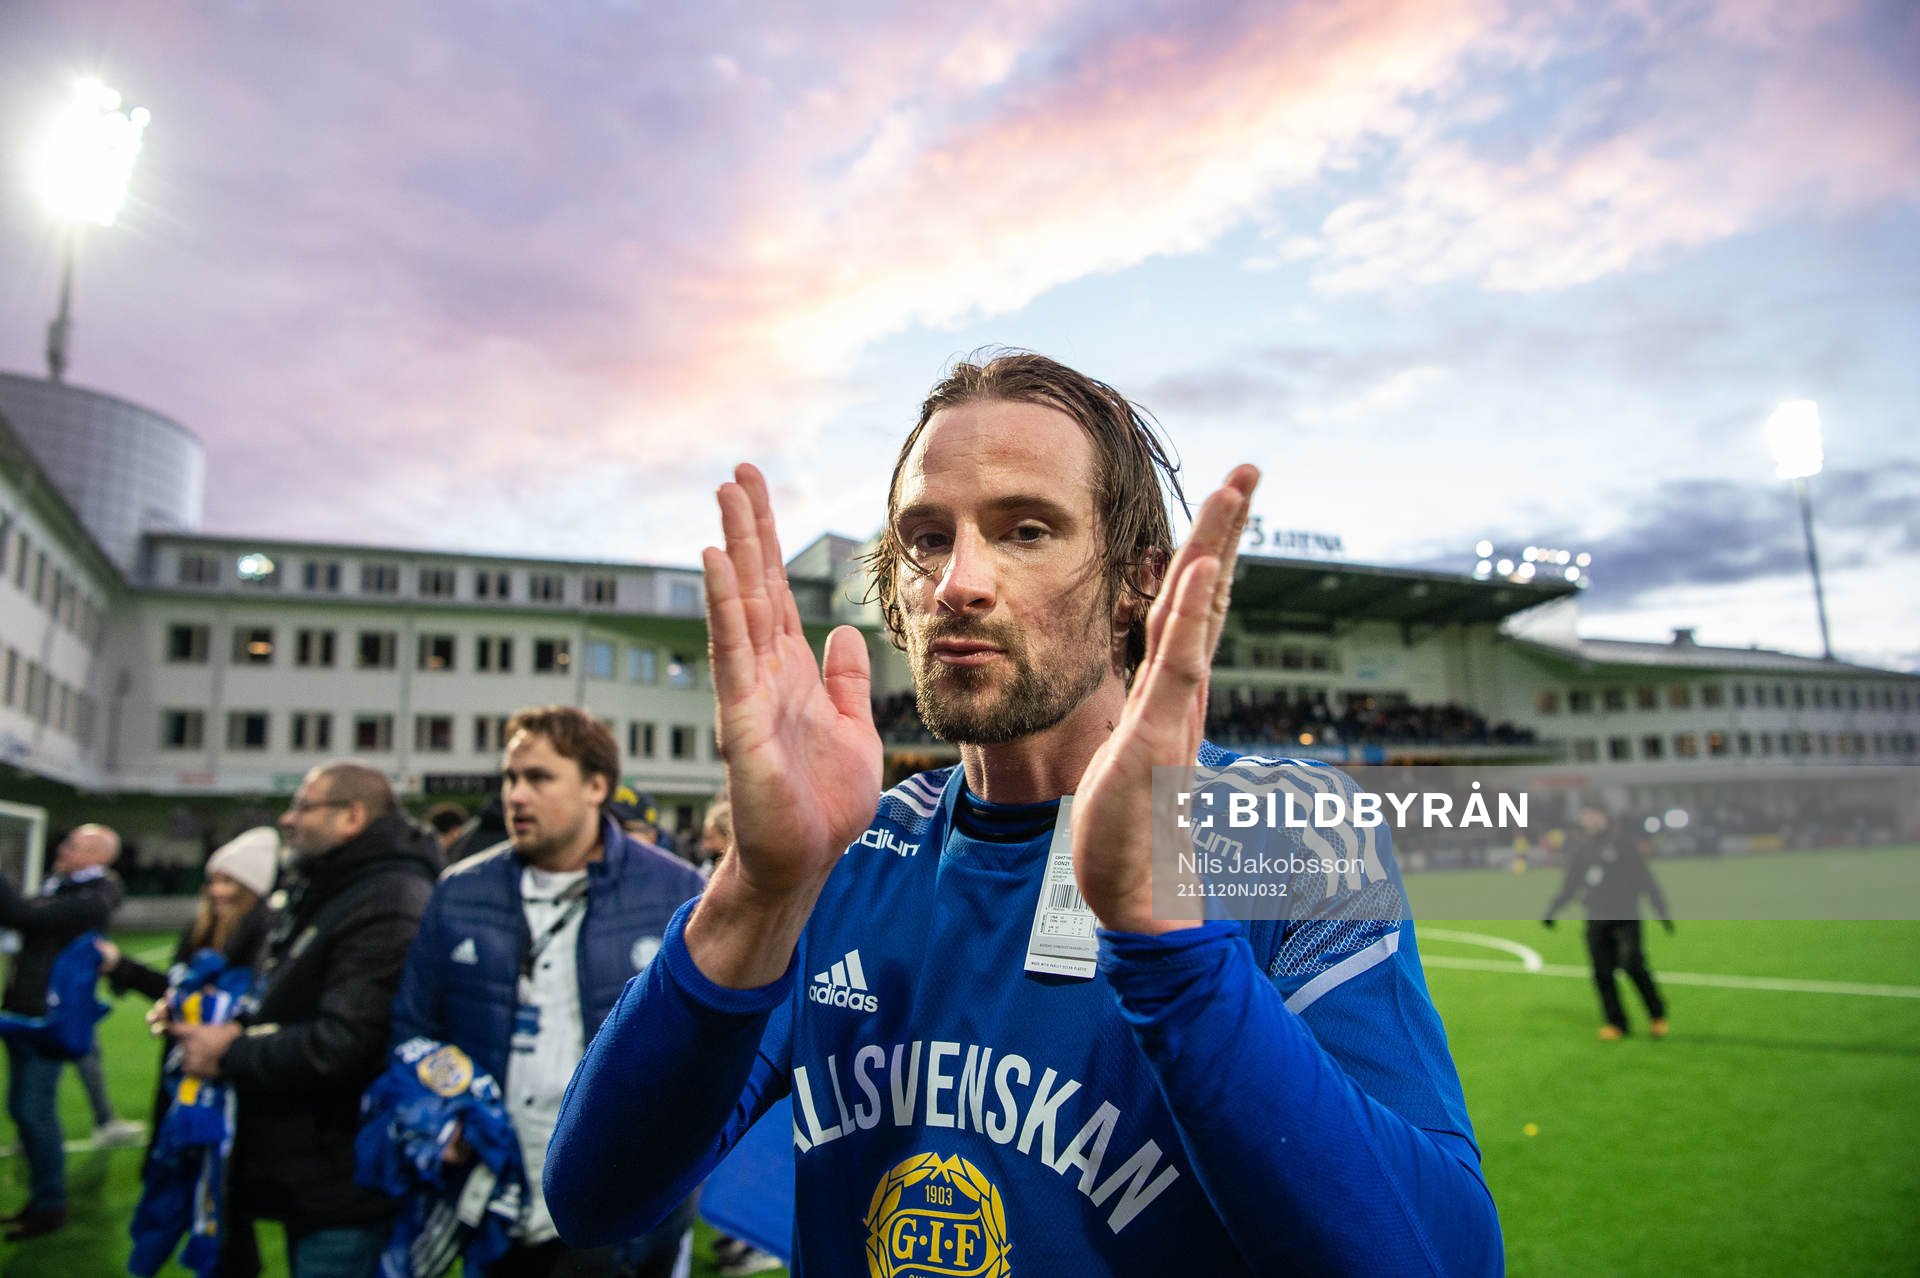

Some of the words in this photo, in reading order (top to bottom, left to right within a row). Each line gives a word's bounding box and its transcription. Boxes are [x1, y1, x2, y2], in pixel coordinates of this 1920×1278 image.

[1187, 817, 1243, 861] ium
[809, 983, 879, 1013] adidas
[793, 1041, 1181, 1235] LLSVENSKAN
[925, 1184, 953, 1206] 1903
